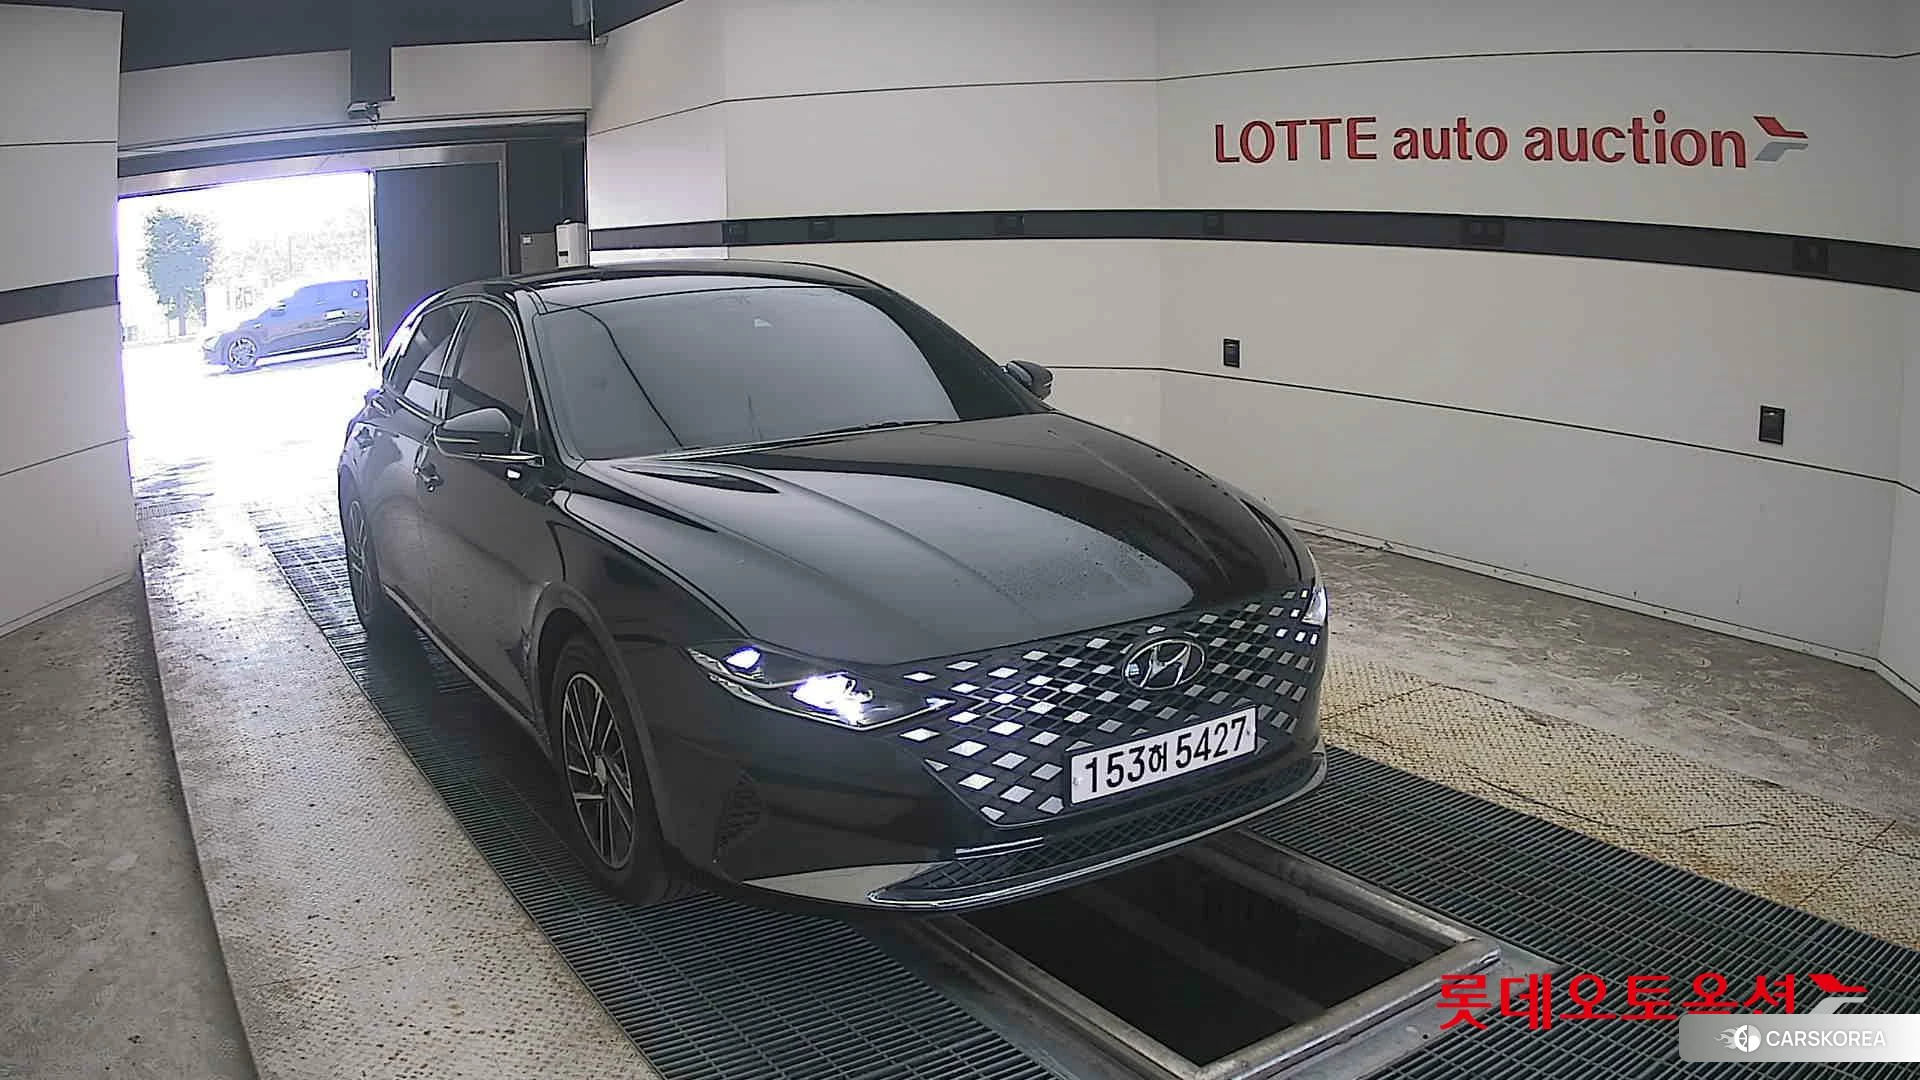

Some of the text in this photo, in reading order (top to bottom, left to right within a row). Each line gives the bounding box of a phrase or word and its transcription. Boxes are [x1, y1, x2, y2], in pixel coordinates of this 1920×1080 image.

[1215, 109, 1748, 169] LOTTE auto auction
[1085, 716, 1247, 793] 153허 5427
